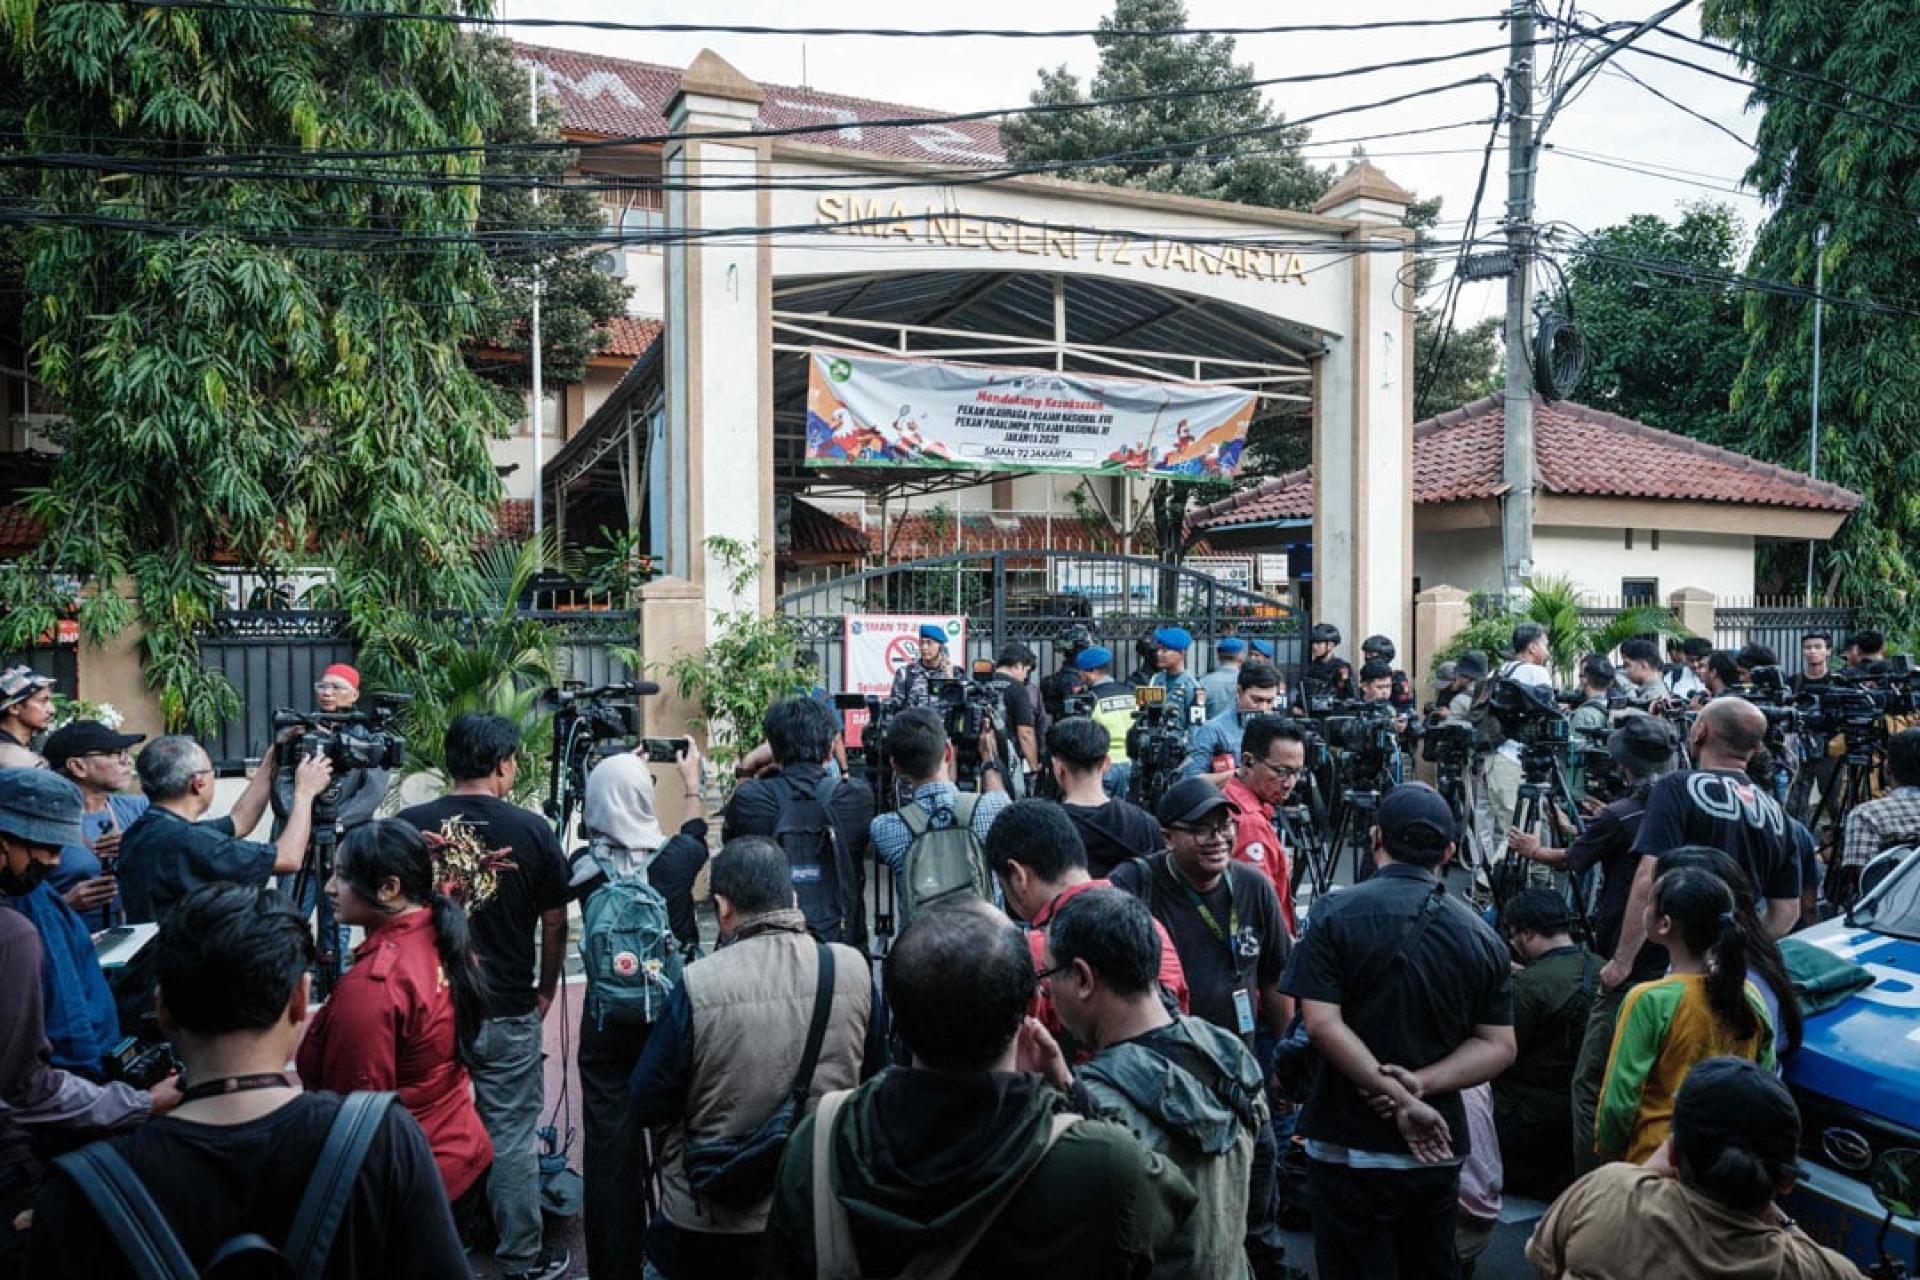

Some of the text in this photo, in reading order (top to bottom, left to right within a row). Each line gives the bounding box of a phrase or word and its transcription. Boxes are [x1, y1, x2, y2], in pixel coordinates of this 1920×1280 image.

[816, 192, 914, 242] SMA
[926, 204, 1078, 260] NEGERI
[1143, 238, 1308, 285] JAKARTA
[976, 389, 1042, 408] Mendukung
[957, 405, 985, 416] PEKAN
[955, 417, 982, 428] PEKAN
[1004, 433, 1038, 443] JAKARTA
[984, 447, 1073, 459] SMAN 72 JAKARTA
[1687, 773, 1784, 836] CNN
